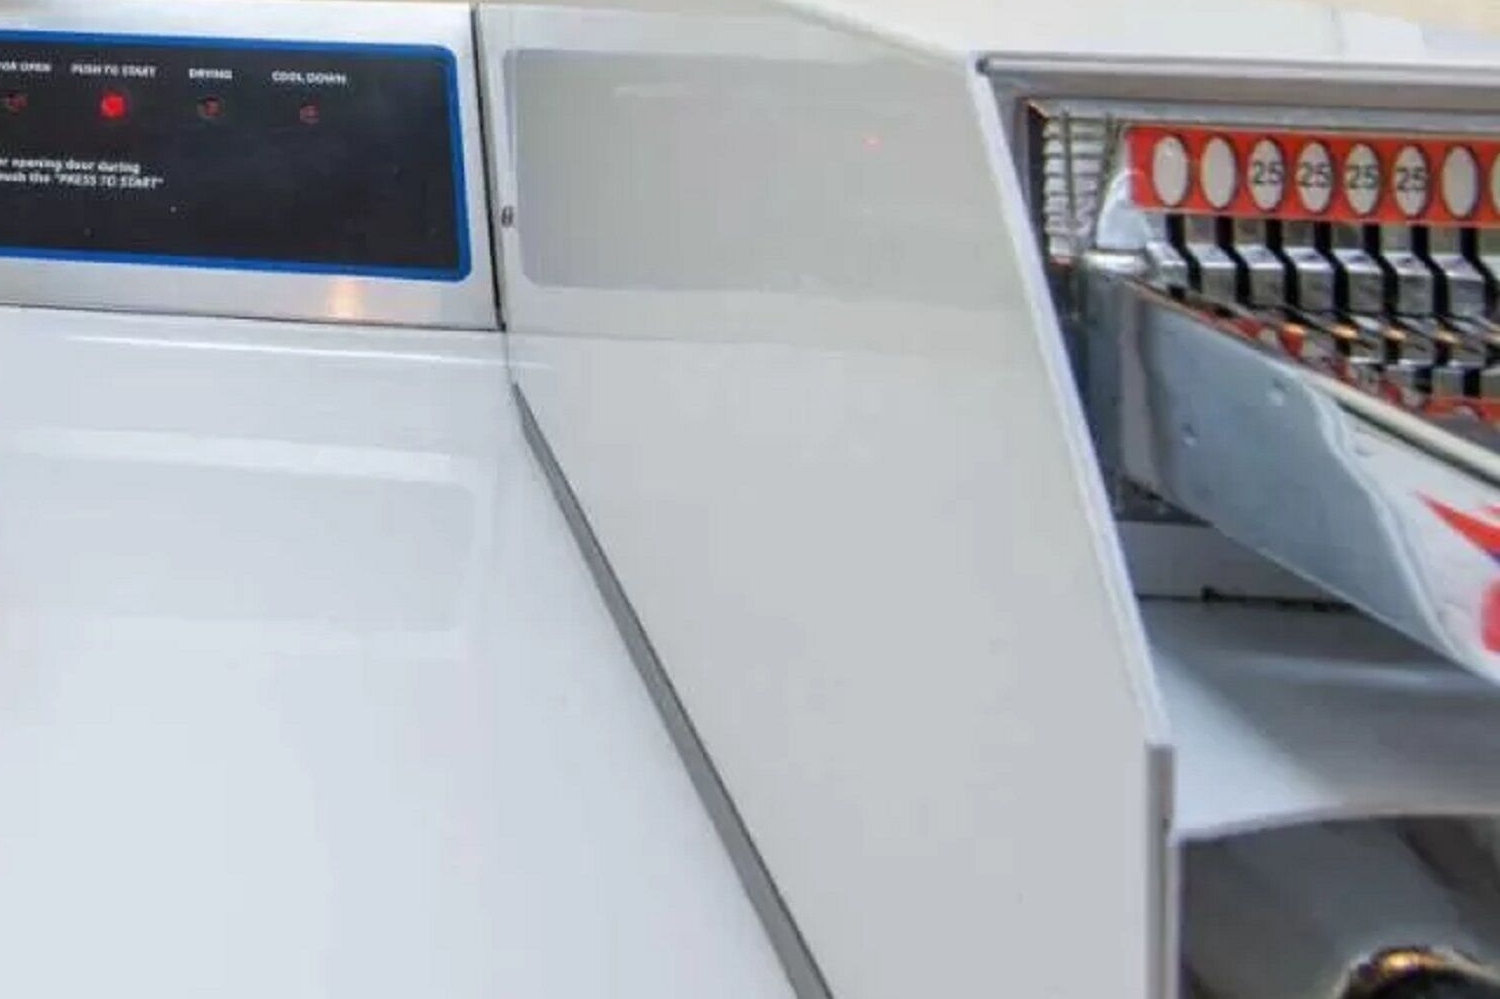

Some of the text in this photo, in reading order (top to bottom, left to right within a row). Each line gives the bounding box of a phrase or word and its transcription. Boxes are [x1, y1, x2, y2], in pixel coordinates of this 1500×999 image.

[20, 61, 52, 73] OPEN
[70, 63, 156, 78] PUSH TO START
[188, 68, 233, 80] DRYING
[271, 71, 347, 85] COOL DOWN
[11, 157, 62, 172] opening
[65, 158, 95, 170] door
[98, 160, 141, 175] during
[1252, 160, 1284, 185] 25
[29, 173, 51, 183] the
[100, 175, 116, 187] TO
[1300, 162, 1331, 187] 25
[1347, 164, 1379, 189] 25
[1396, 166, 1427, 191] 25
